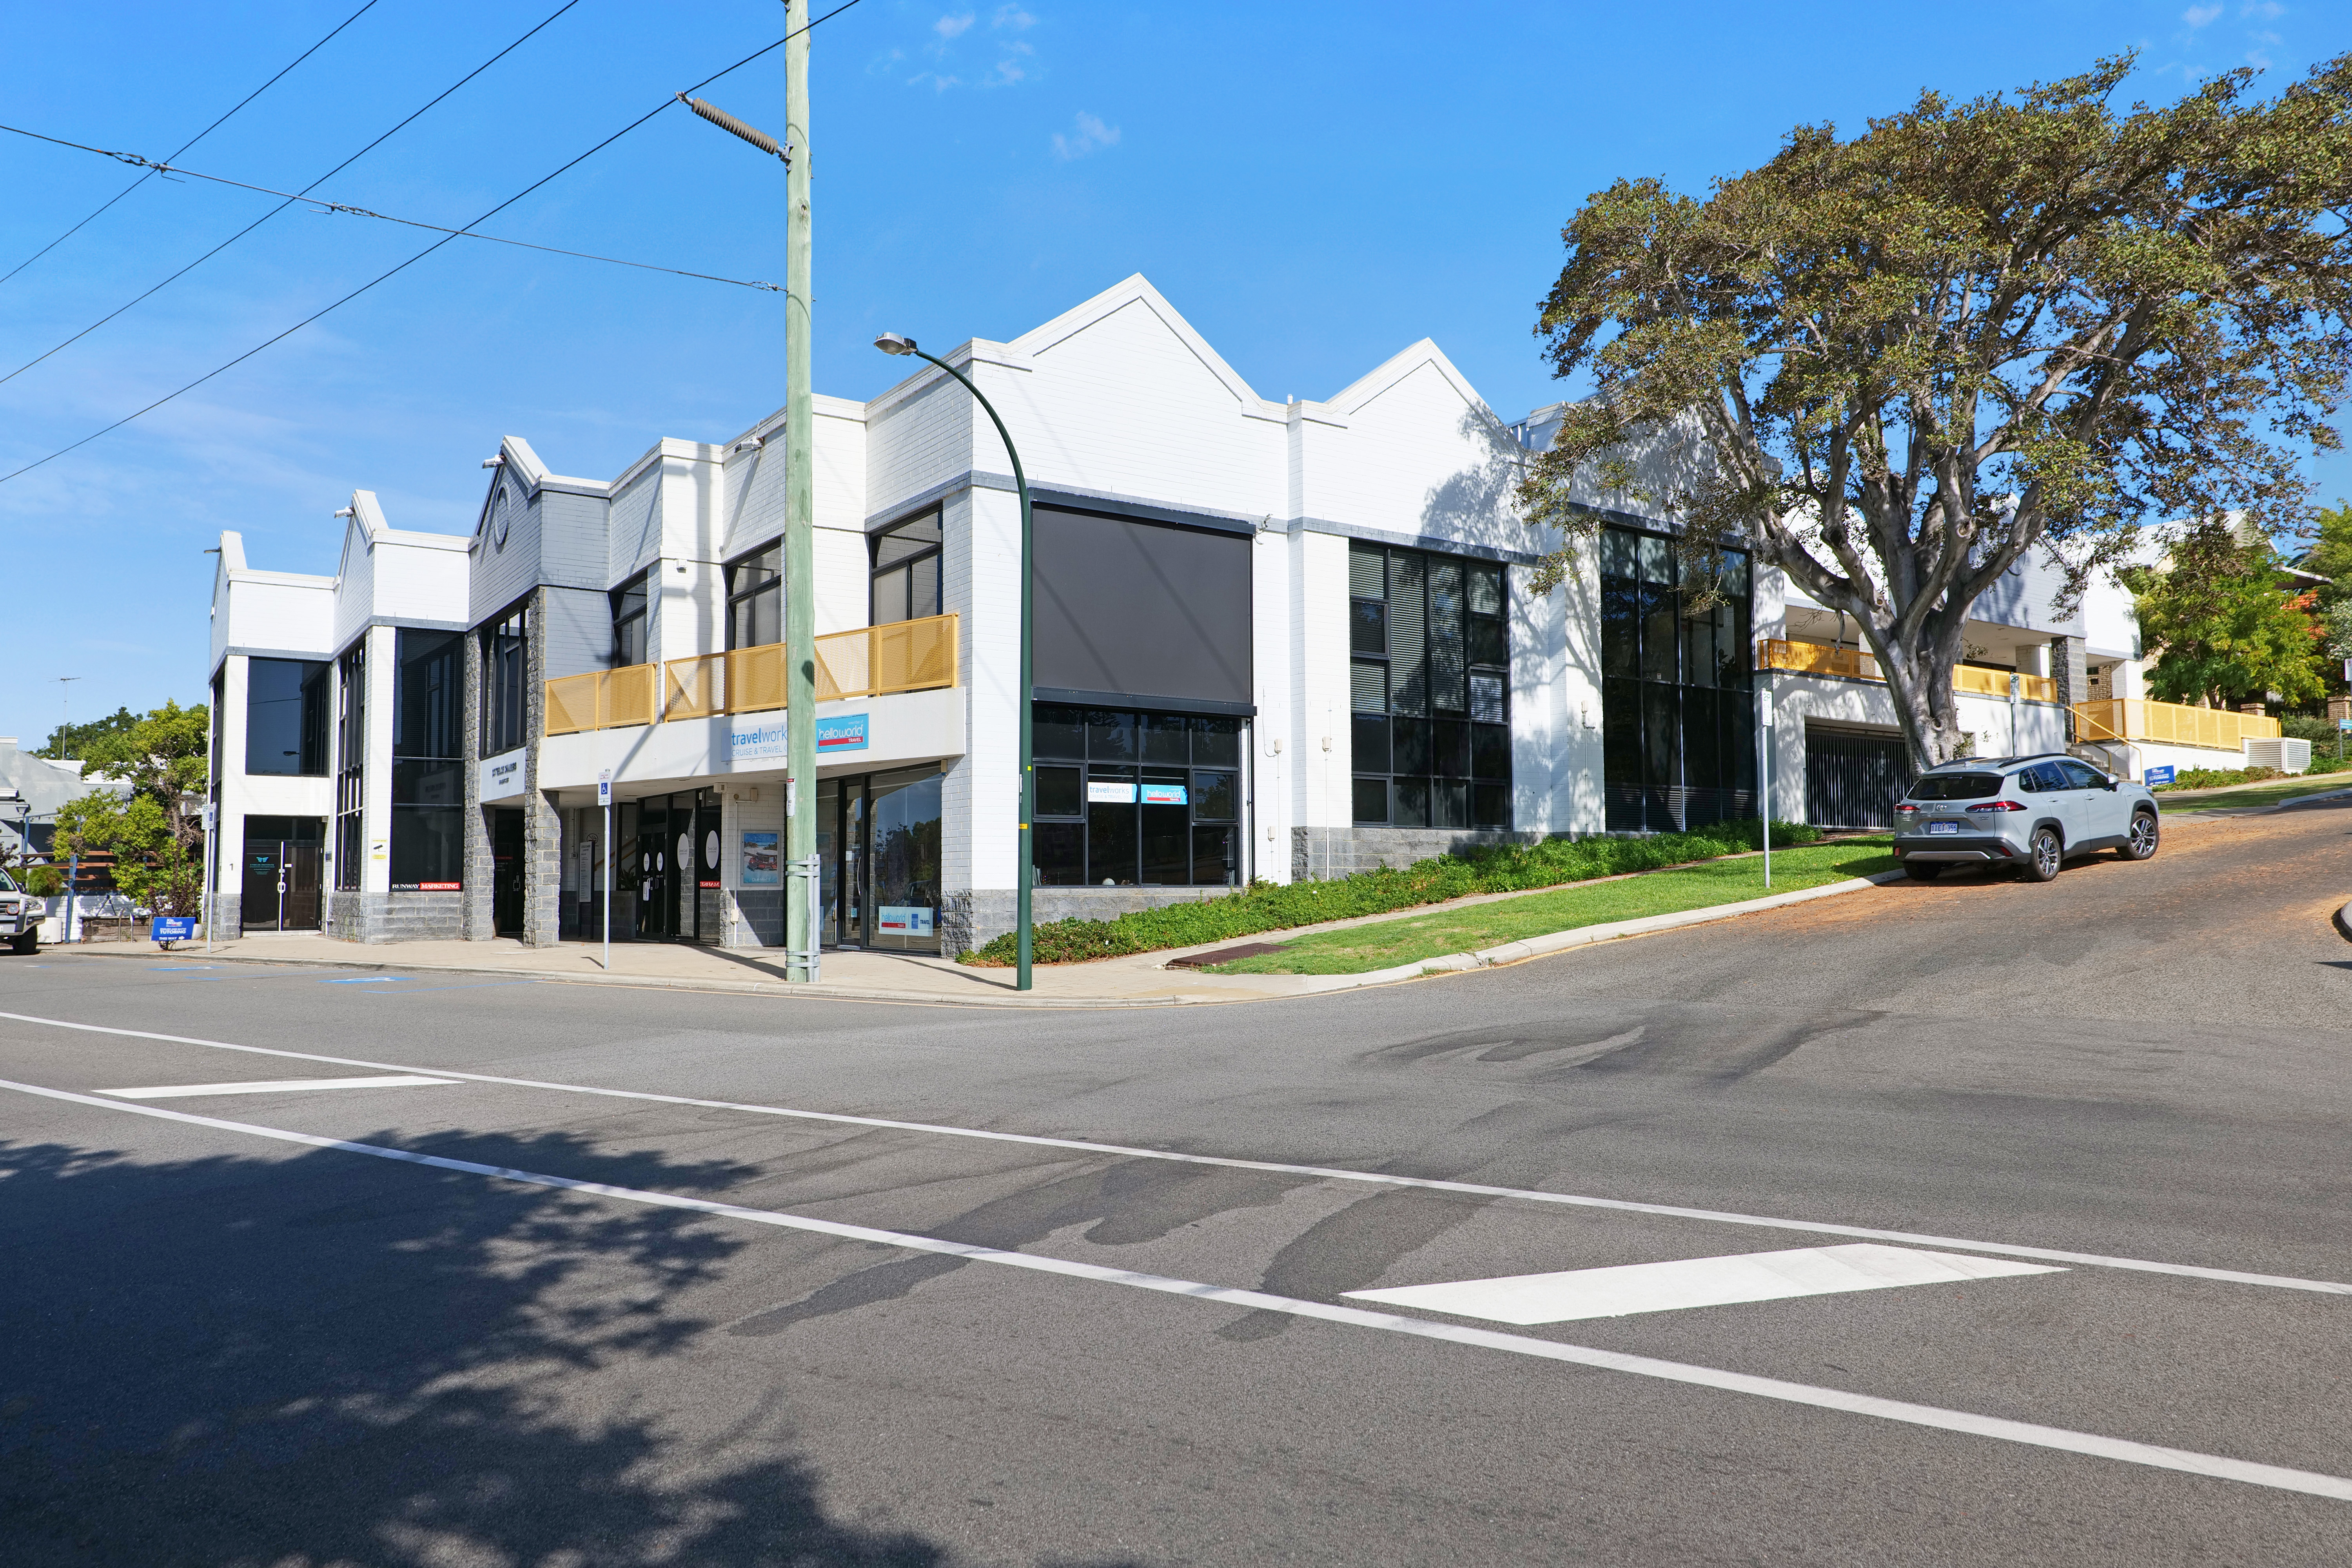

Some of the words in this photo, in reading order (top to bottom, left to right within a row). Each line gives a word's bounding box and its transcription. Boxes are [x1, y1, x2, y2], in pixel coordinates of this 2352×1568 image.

[1763, 693, 1771, 701] 2P
[731, 725, 787, 746] travelwork
[818, 724, 863, 739] helloworld
[731, 748, 752, 757] CRUISE
[760, 746, 782, 754] TRAVEL
[882, 913, 906, 922] helloworld
